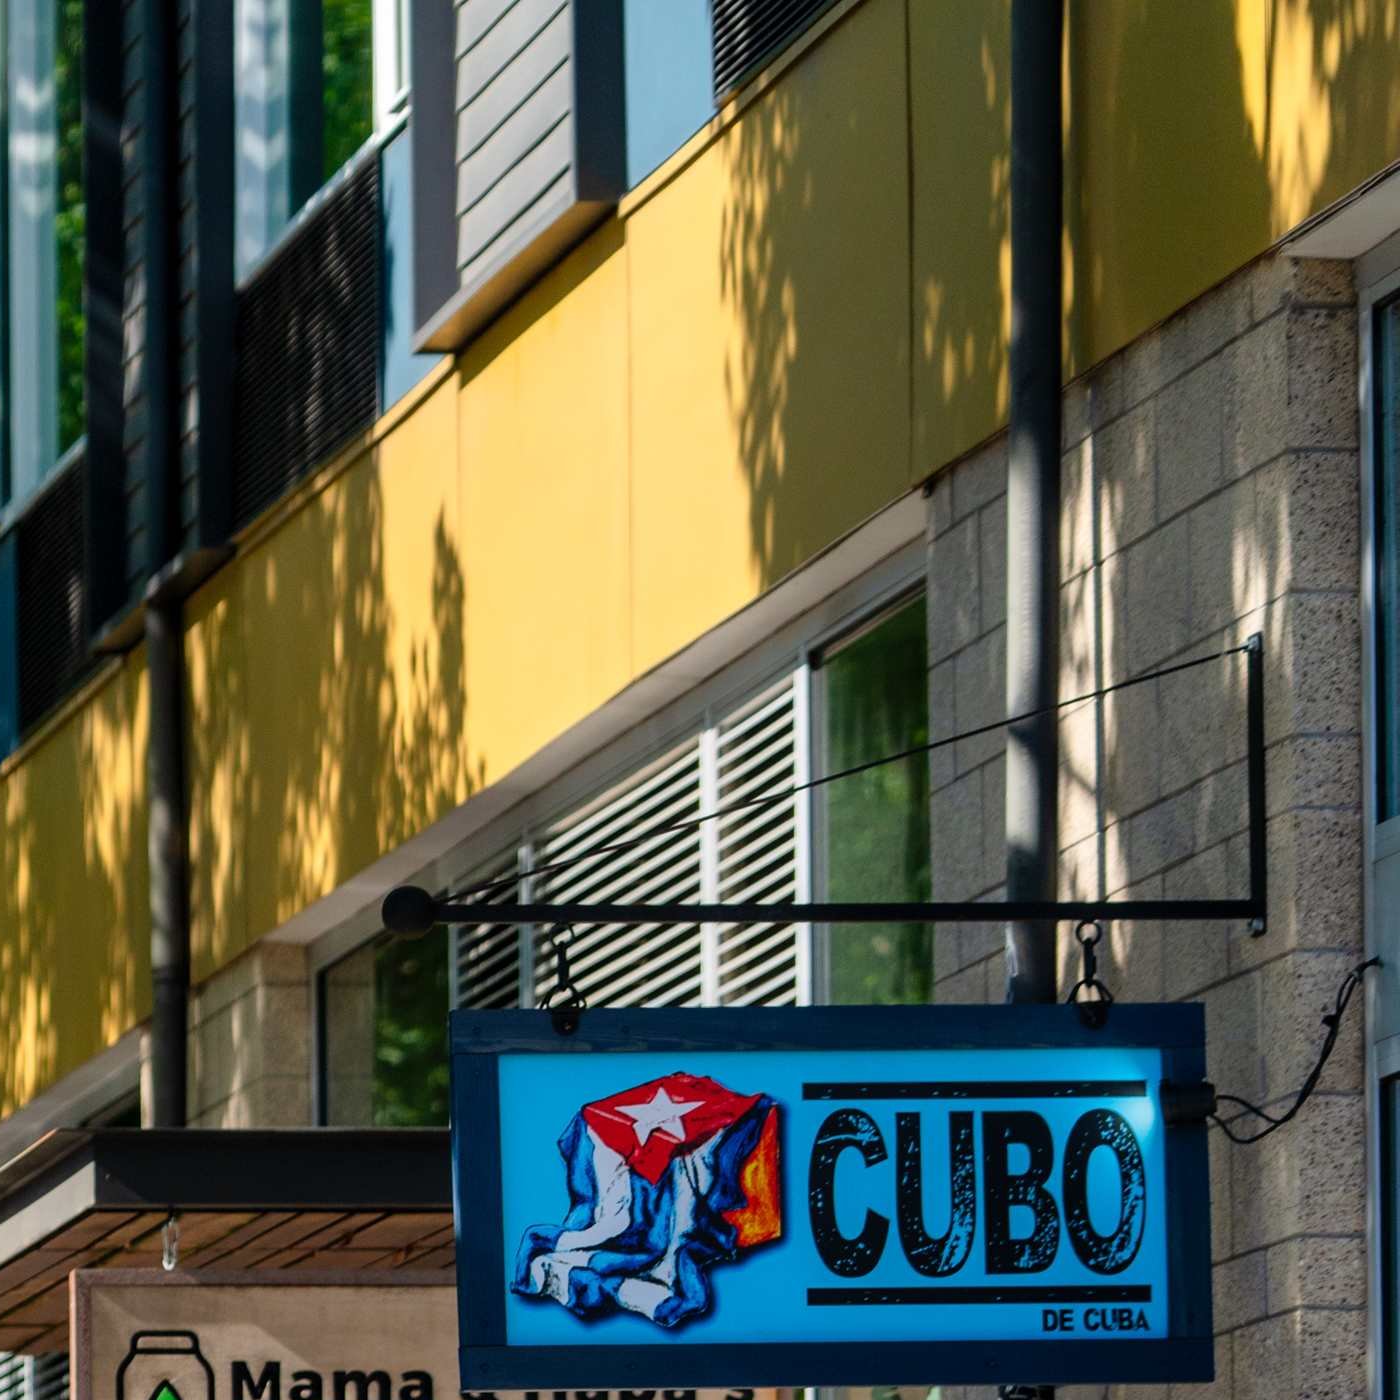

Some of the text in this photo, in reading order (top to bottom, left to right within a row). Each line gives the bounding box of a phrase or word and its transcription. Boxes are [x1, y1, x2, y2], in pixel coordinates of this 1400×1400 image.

[808, 1107, 1146, 1278] CUBO
[1042, 1308, 1150, 1331] DE CUBA
